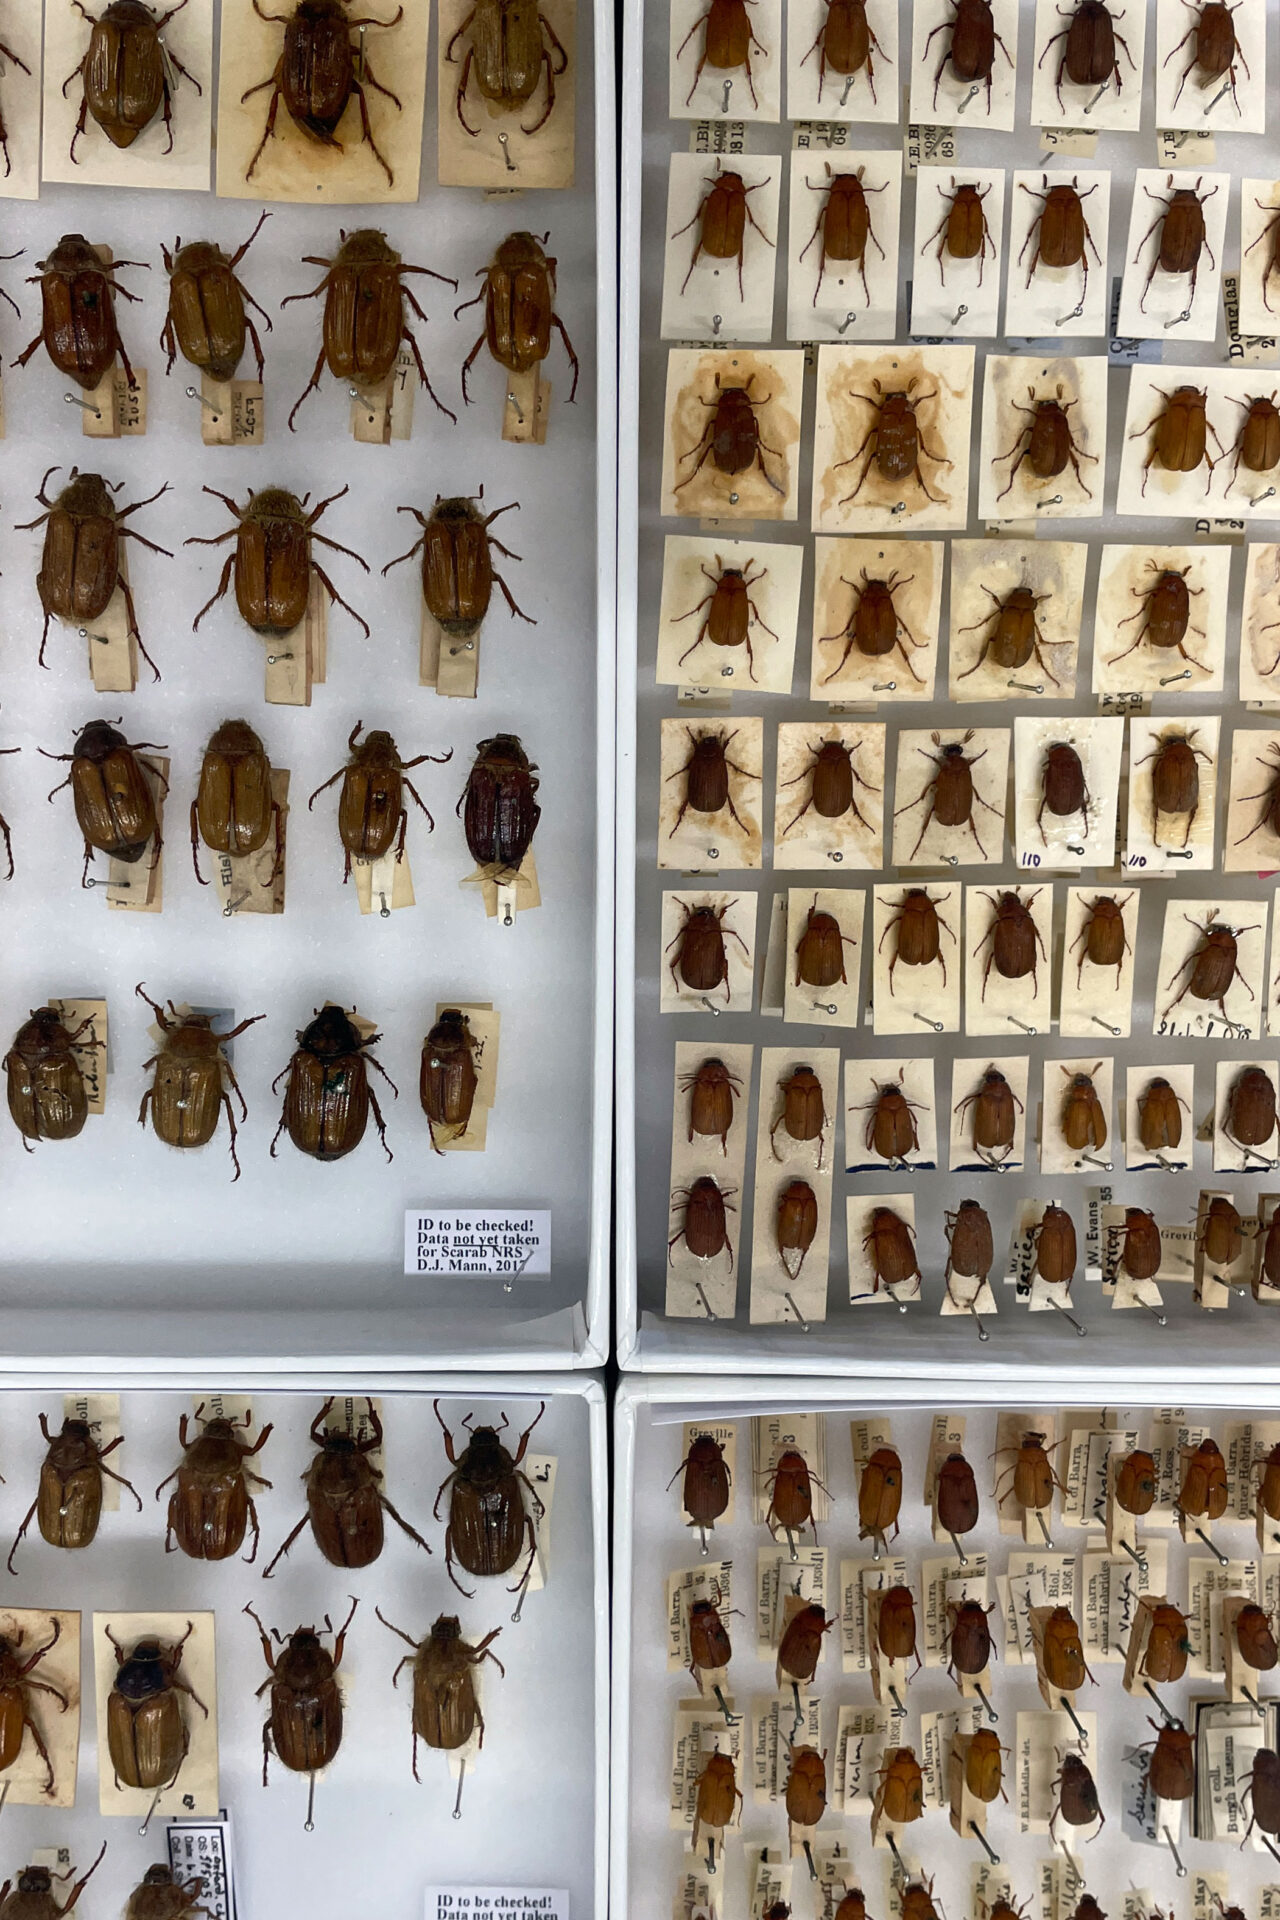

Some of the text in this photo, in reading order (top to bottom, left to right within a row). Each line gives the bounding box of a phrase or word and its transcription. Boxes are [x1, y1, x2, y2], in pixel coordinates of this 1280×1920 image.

[1224, 278, 1244, 359] Douglas
[417, 1218, 534, 1233] ID to be checked!
[1086, 1200, 1099, 1241] Evans
[417, 1231, 540, 1250] Data not yet taken
[1160, 1229, 1199, 1242] Grevil
[417, 1245, 524, 1259] for Scarab NRS
[417, 1258, 444, 1272] D.J.
[448, 1259, 493, 1274] Mann,
[689, 1427, 734, 1440] Greville
[1069, 1443, 1083, 1482] Barra,
[1237, 1423, 1254, 1521] Outer Hebrides
[1068, 1485, 1078, 1498] of
[759, 1569, 773, 1608] Barra,
[1047, 1569, 1060, 1599] Biol.
[927, 1579, 940, 1619] Barra,
[1086, 1573, 1098, 1612] Barra,
[670, 1586, 685, 1627] Barra,
[842, 1583, 855, 1622] Barra,
[759, 1612, 770, 1625] of
[1087, 1616, 1097, 1629] of
[670, 1630, 681, 1643] of
[843, 1627, 853, 1640] of
[927, 1623, 937, 1636] of
[755, 1716, 768, 1756] Barra,
[673, 1736, 686, 1778] Barra,
[687, 1720, 701, 1780] Hebrides
[755, 1761, 767, 1774] of
[924, 1770, 935, 1784] of
[1224, 1735, 1239, 1834] Burgh Museum
[672, 1782, 683, 1796] of
[436, 1893, 553, 1909] ID to be checked!
[436, 1908, 468, 1920] Data
[473, 1911, 494, 1920] not
[522, 1909, 559, 1920] taken
